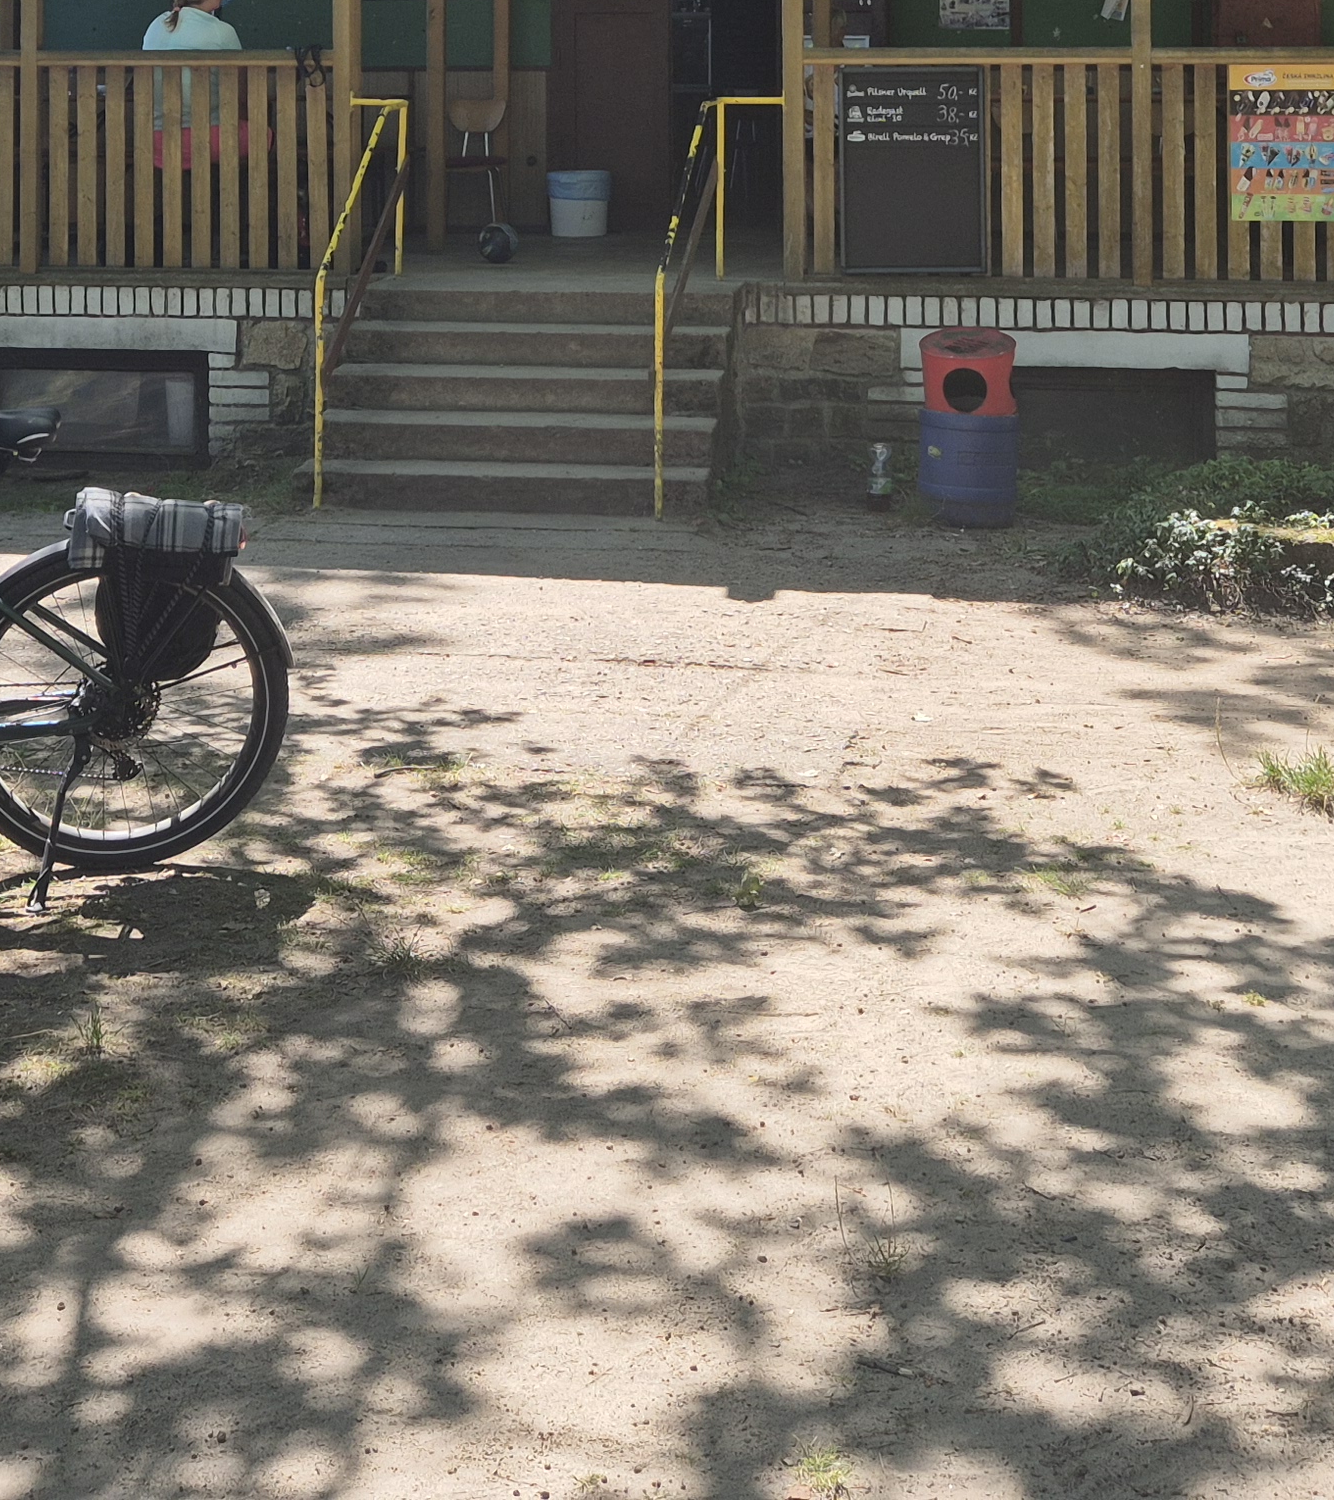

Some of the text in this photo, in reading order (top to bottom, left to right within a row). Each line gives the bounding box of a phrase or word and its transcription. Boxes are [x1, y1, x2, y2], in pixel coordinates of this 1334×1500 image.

[867, 87, 895, 96] Pilsner
[897, 87, 927, 100] Urquell
[867, 105, 904, 118] Radegast
[892, 114, 902, 122] 10
[867, 132, 890, 141] Birell
[893, 132, 923, 141] Pomelo
